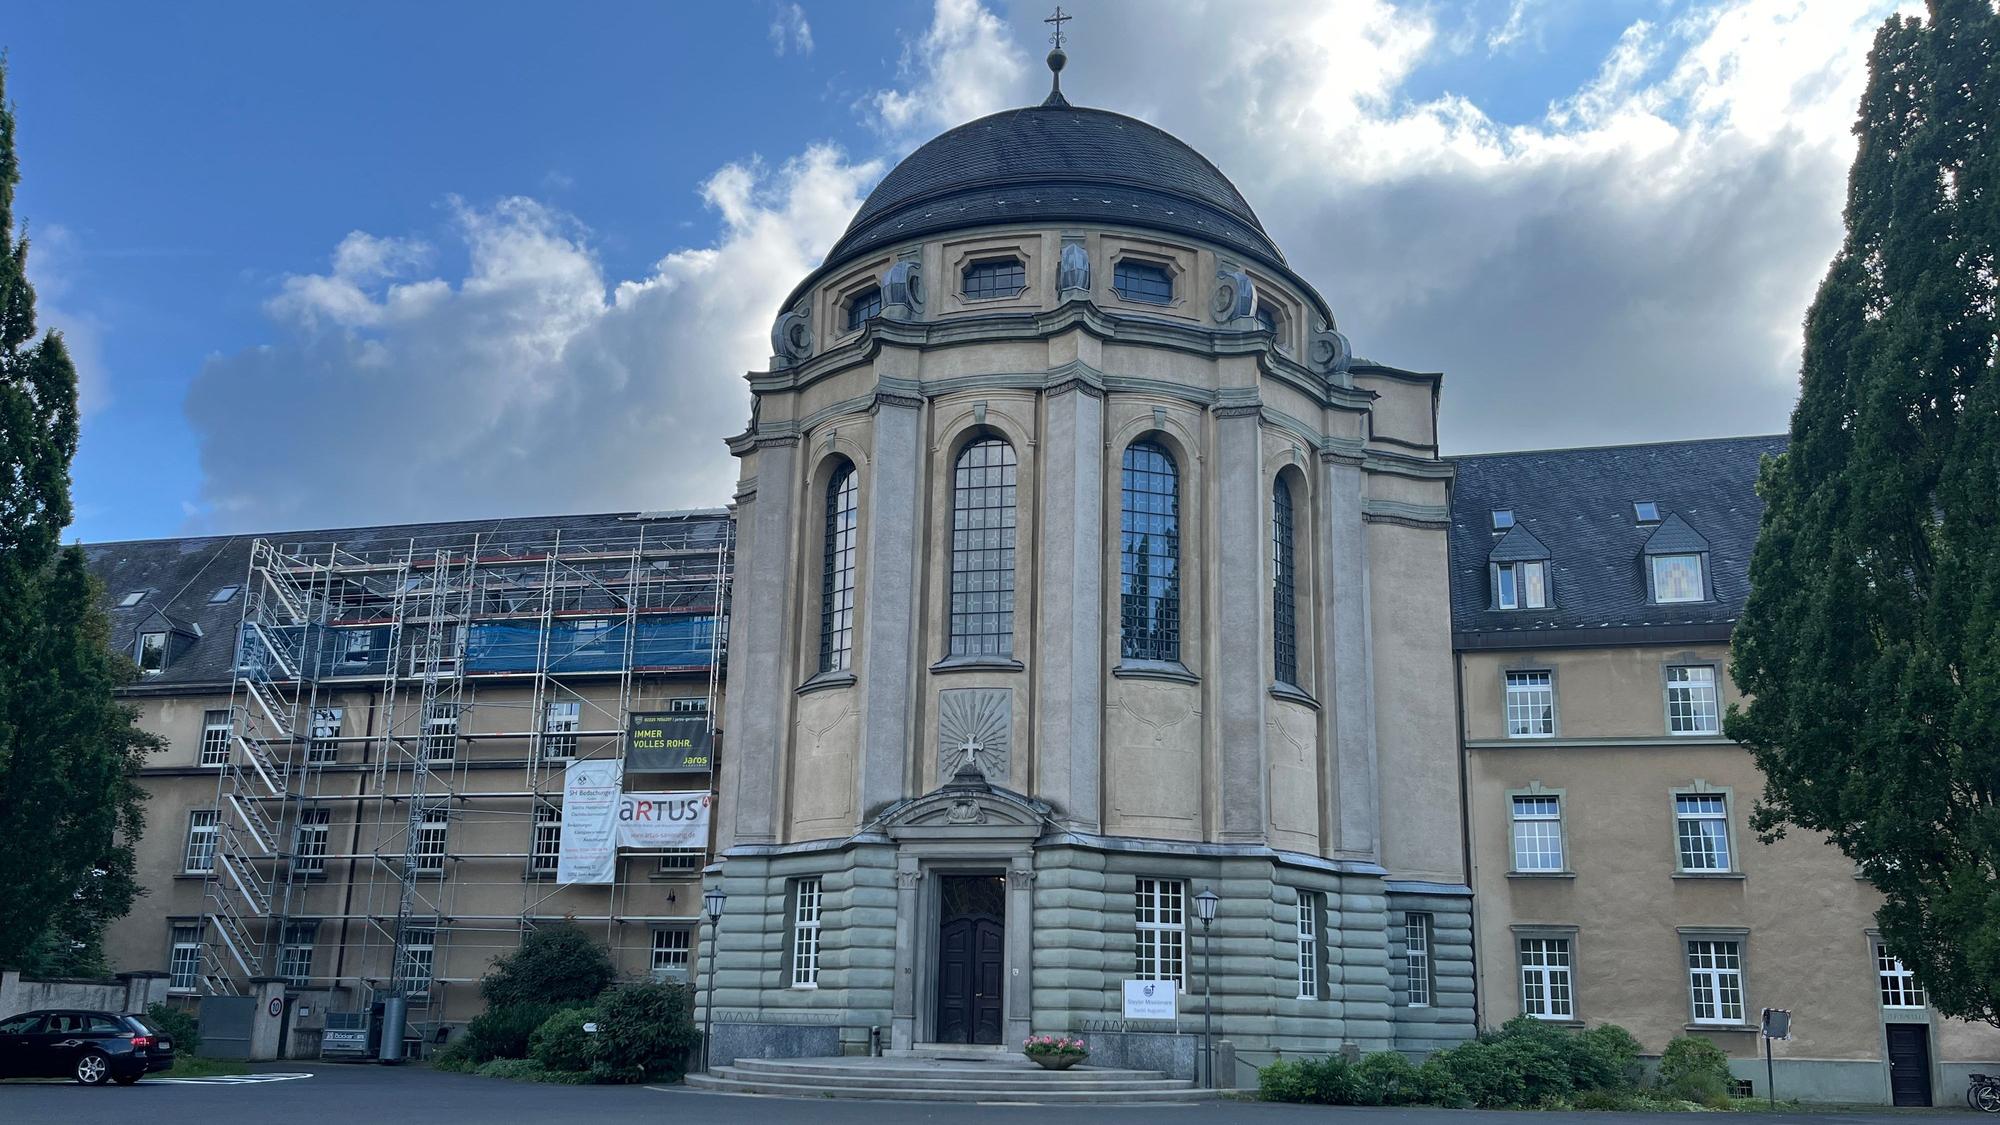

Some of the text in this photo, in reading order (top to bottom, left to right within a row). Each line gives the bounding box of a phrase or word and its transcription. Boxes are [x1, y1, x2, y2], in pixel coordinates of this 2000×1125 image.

[634, 730, 662, 738] IMMER
[633, 740, 692, 748] VOLLES ROHR.
[272, 1002, 280, 1012] 10
